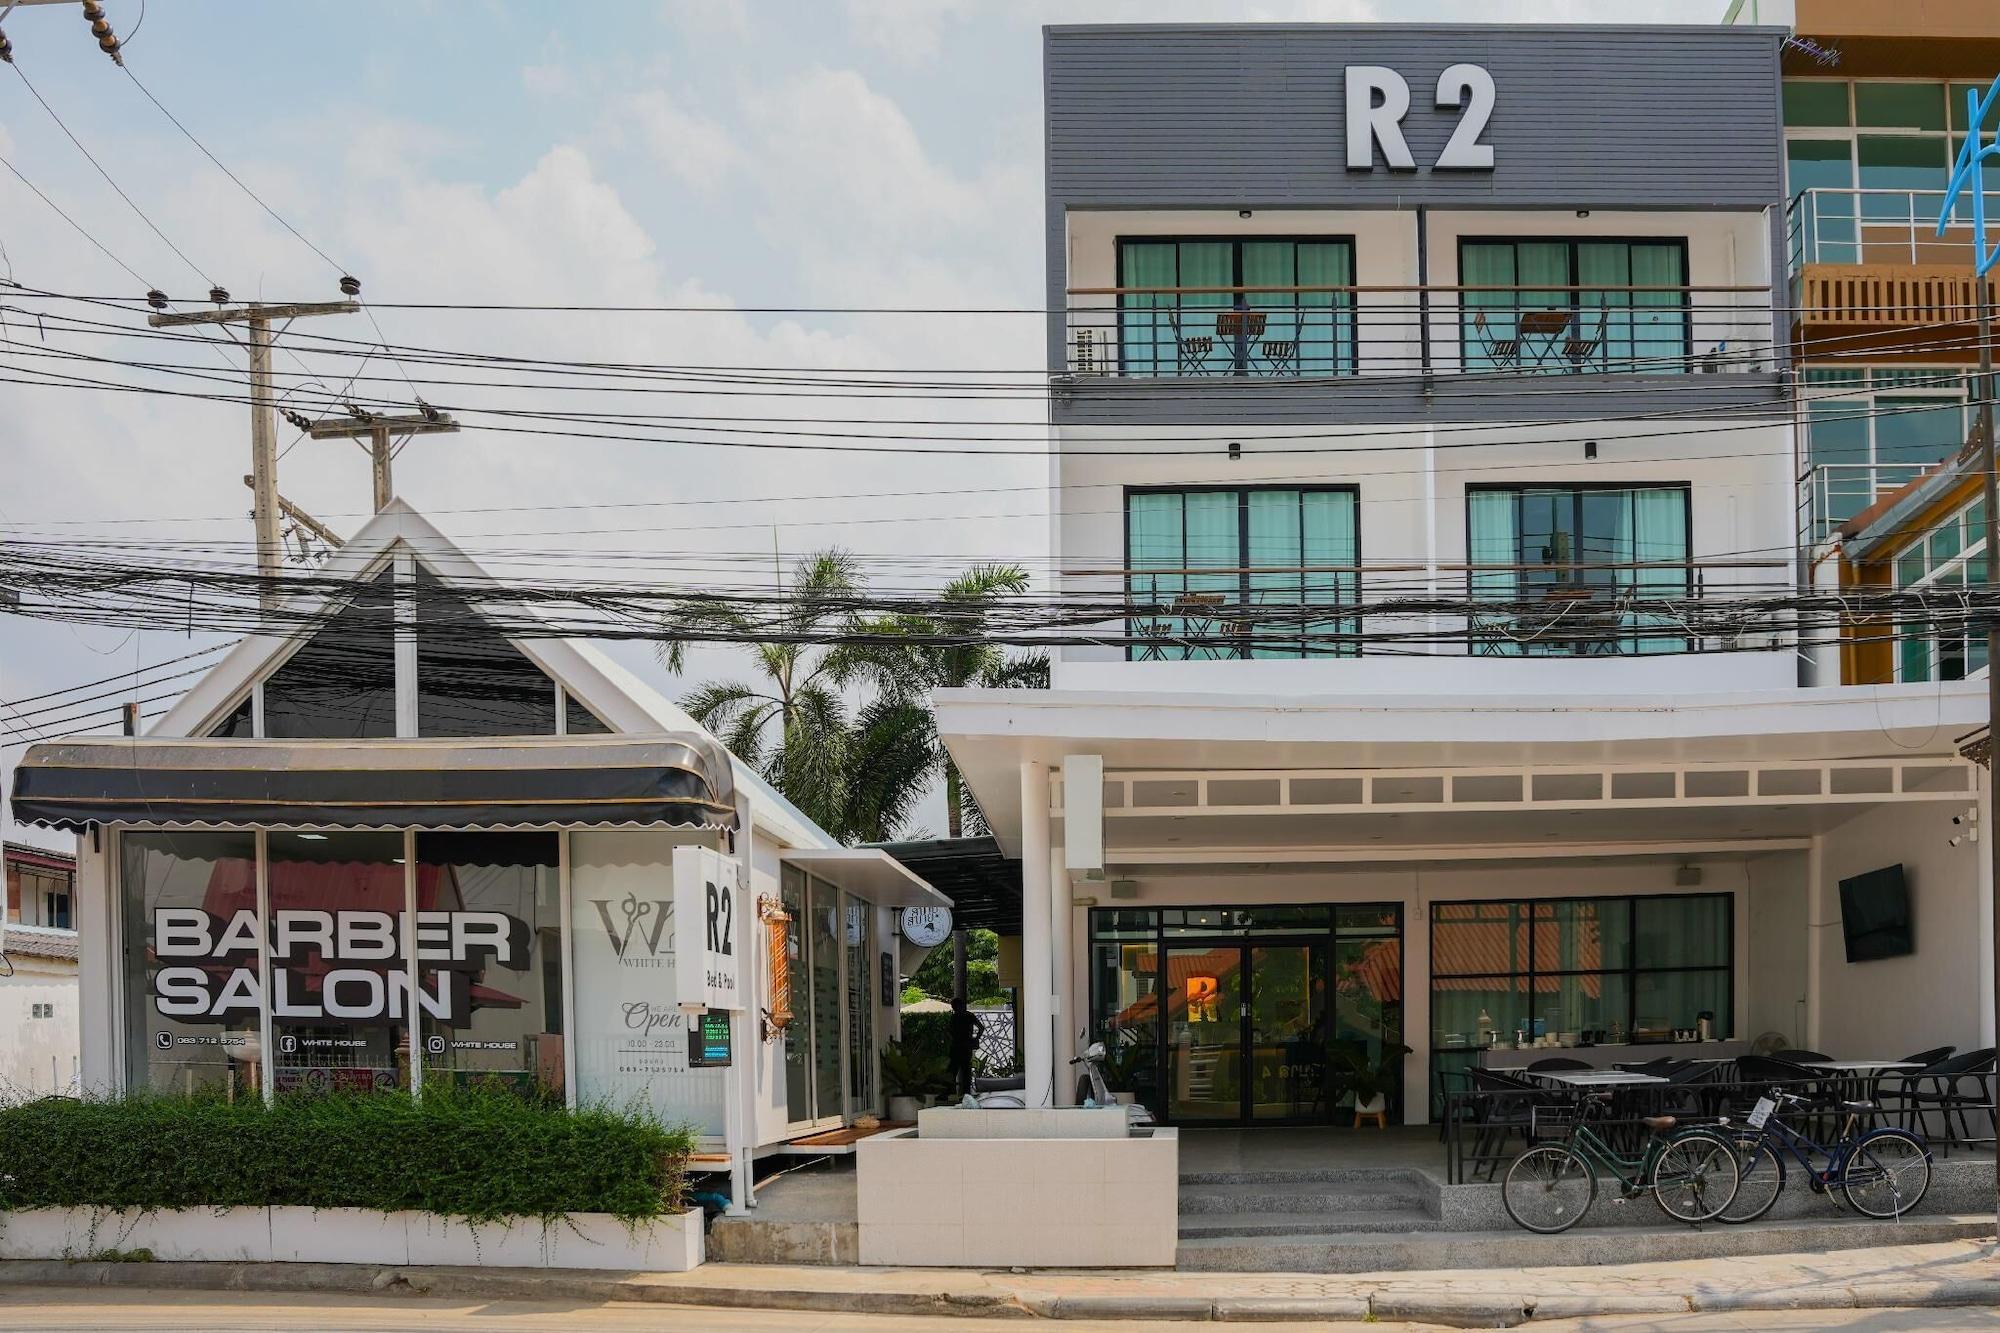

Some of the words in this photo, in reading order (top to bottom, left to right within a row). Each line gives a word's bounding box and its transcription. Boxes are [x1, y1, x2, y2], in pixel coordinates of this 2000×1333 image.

[154, 908, 512, 962] BARBER
[706, 880, 732, 956] R2
[623, 958, 665, 968] WHITE
[154, 966, 453, 1020] SALON
[621, 1001, 681, 1037] Open
[302, 1039, 333, 1047] WHITE
[334, 1039, 367, 1047] HOUSE
[450, 1041, 482, 1049] WHITE
[483, 1041, 517, 1049] HOUSE
